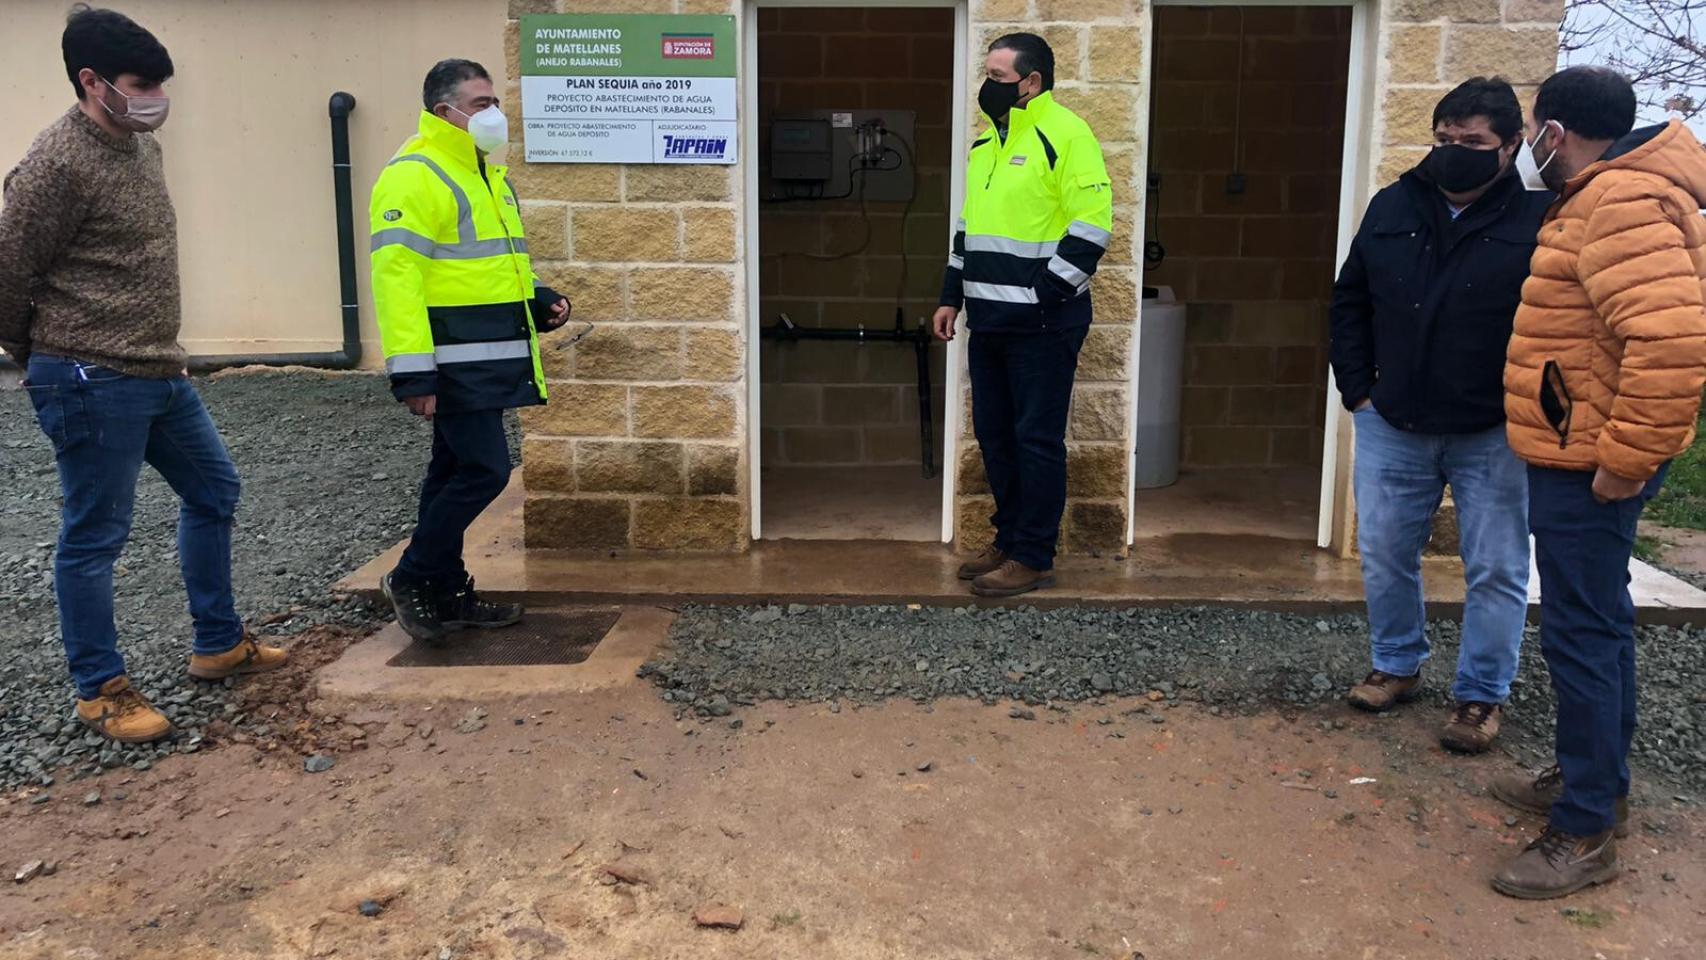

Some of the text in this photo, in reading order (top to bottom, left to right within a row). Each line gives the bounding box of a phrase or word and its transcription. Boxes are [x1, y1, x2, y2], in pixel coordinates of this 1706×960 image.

[535, 28, 622, 39] AYUNTAMIENTO
[536, 43, 622, 54] DE MATELLANES
[674, 47, 712, 55] ZAMORA
[536, 57, 622, 68] (ANEJO RABANALES)
[566, 79, 692, 90] PLAN SEQUIA año 2019
[547, 94, 713, 104] PROYECTO ABASTECIMIENTO DE AGUA
[590, 105, 602, 113] EN
[604, 105, 659, 114] MATELLANES
[661, 105, 716, 115] (RABANALES)
